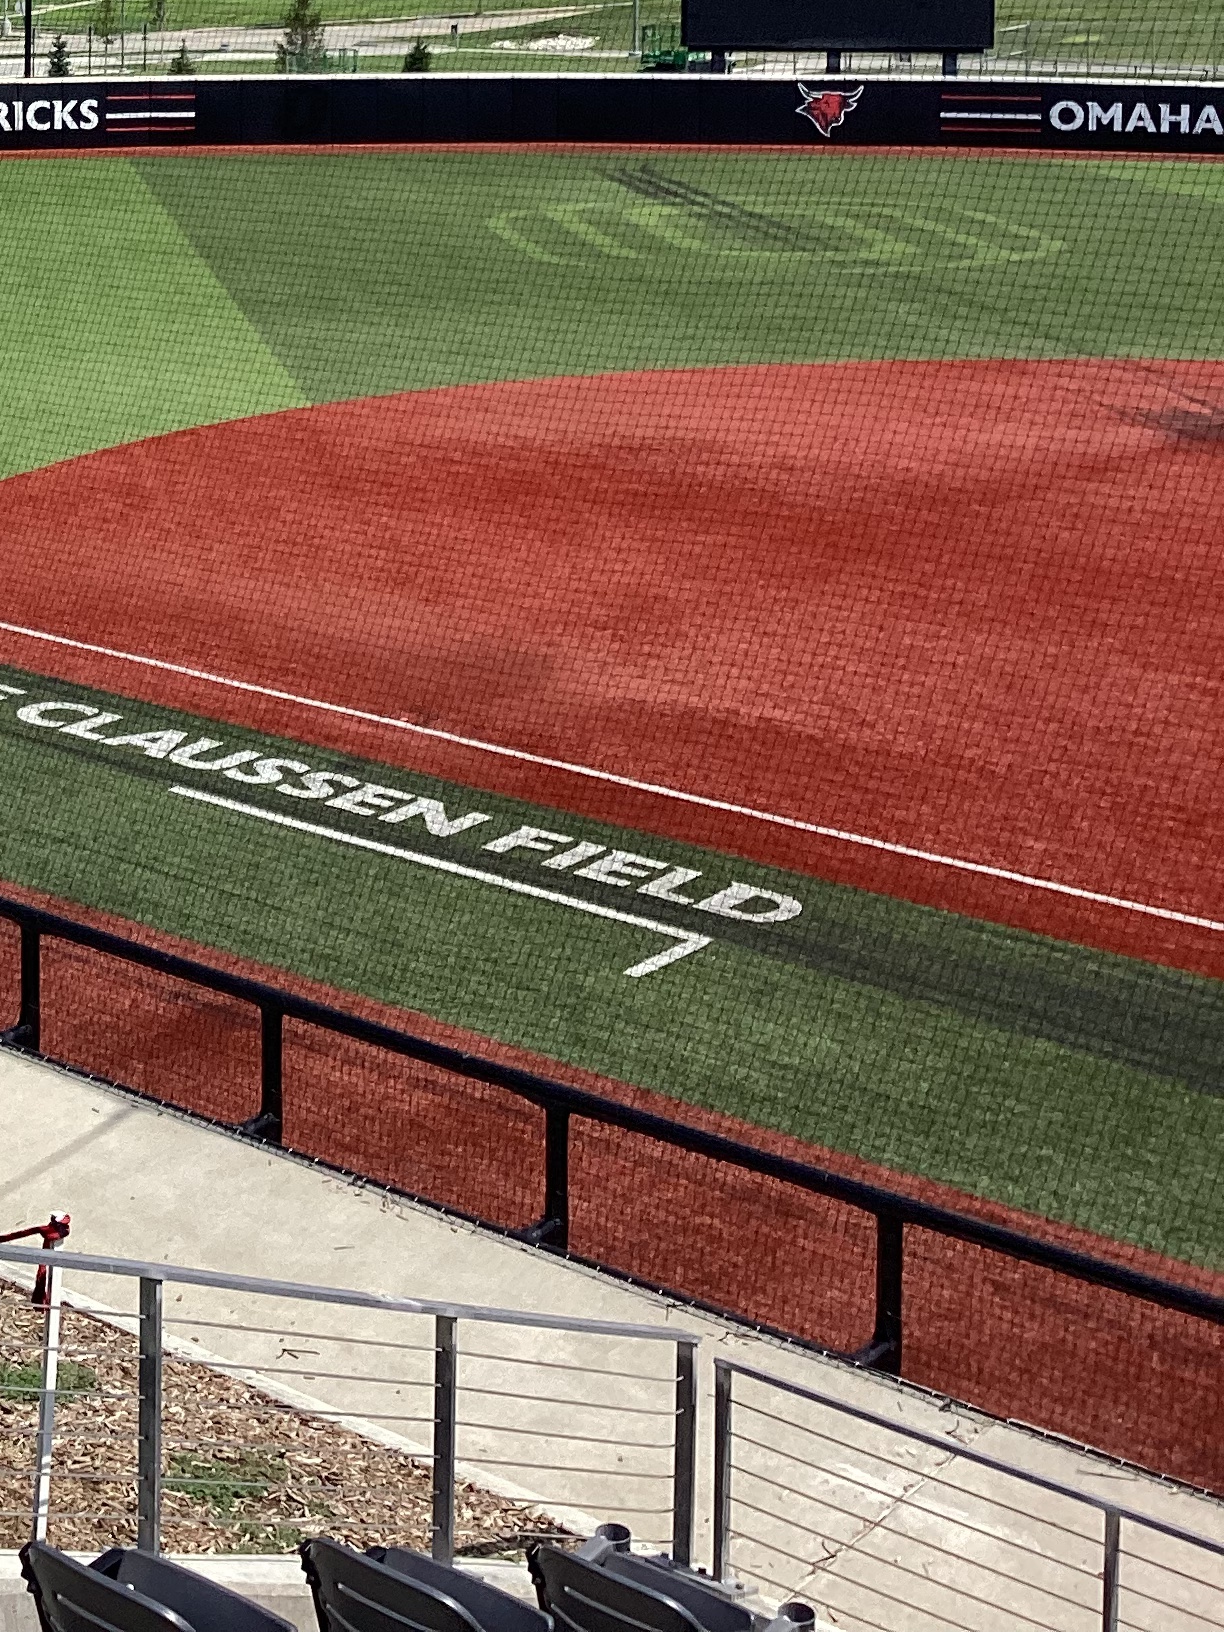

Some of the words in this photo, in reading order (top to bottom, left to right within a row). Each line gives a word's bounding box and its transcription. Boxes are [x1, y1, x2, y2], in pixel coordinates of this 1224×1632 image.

[1049, 100, 1224, 135] OMAHA
[17, 702, 491, 837] CLAUSSEN
[482, 825, 803, 923] FIELD
